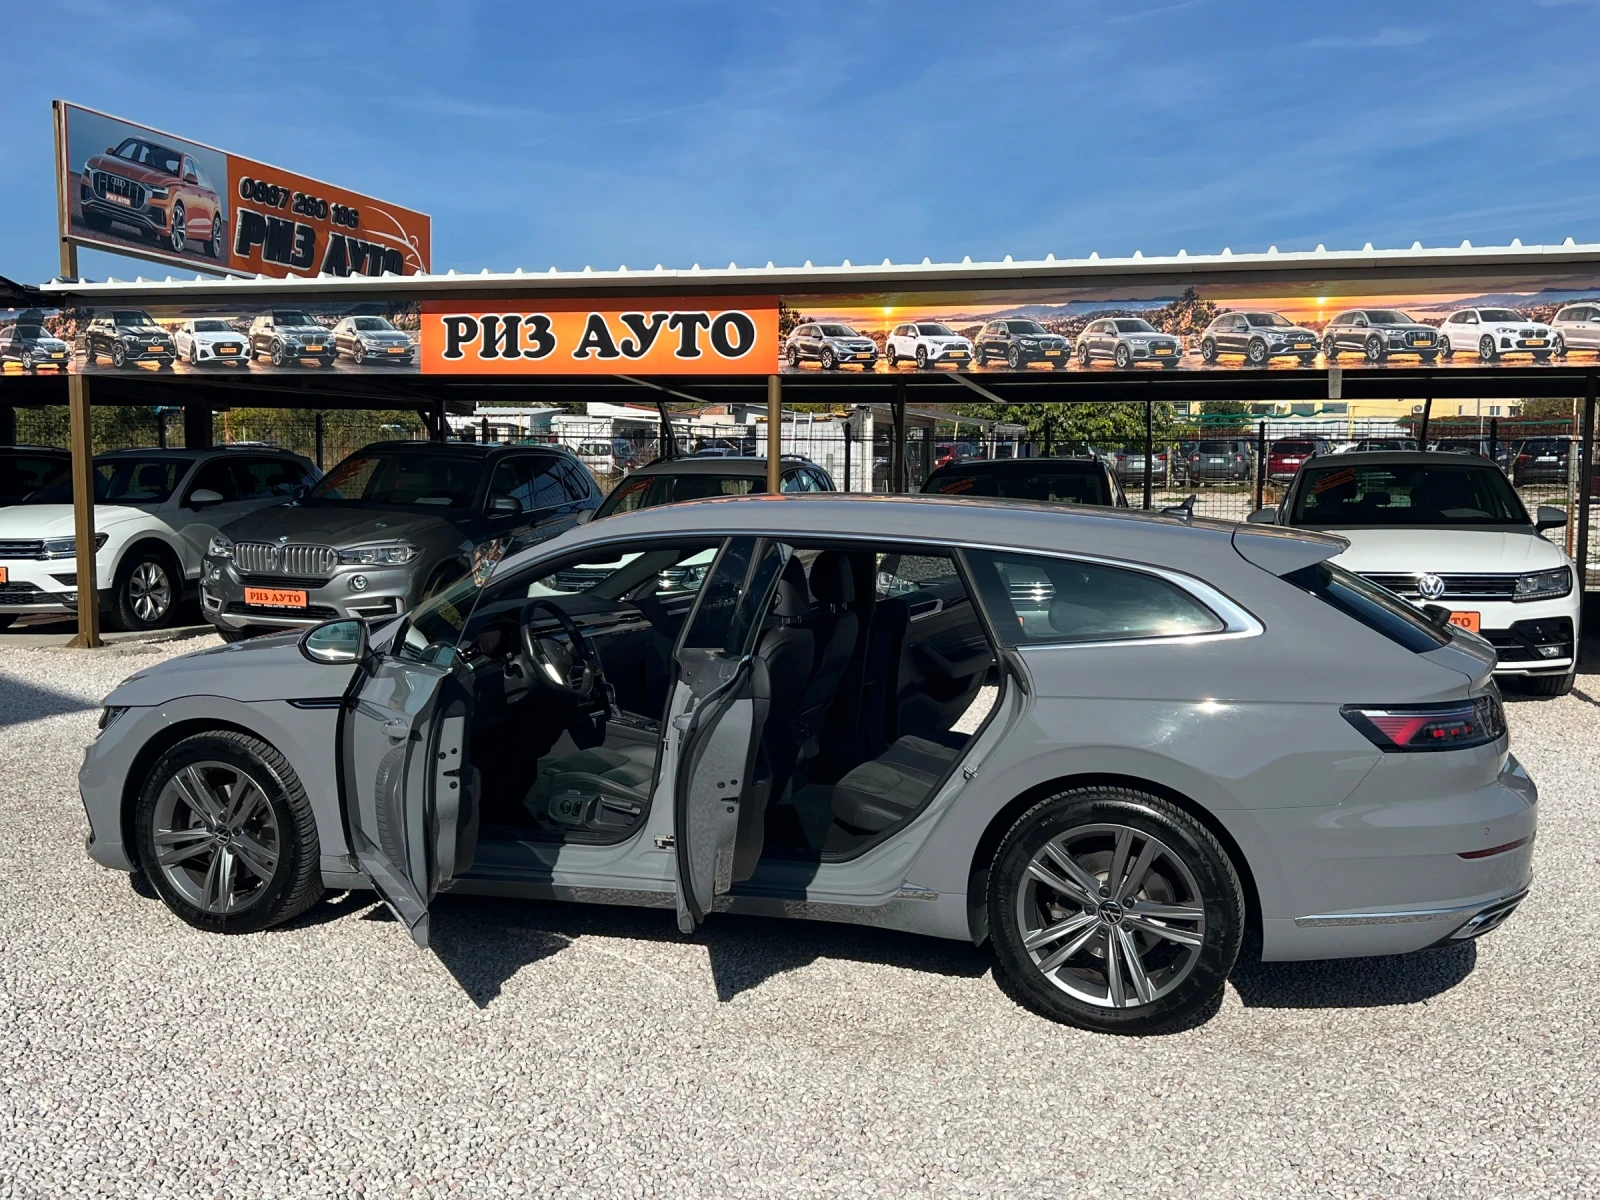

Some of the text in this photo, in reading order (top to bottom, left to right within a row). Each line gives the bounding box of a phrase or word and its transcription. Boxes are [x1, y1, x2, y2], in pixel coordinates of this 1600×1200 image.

[239, 176, 359, 230] 0887 260 186
[234, 207, 405, 277] РИЗ АУТО
[441, 311, 756, 360] РИЗ АУТО
[250, 592, 301, 602] РИЗ АУТО
[1451, 617, 1471, 627] ТО
